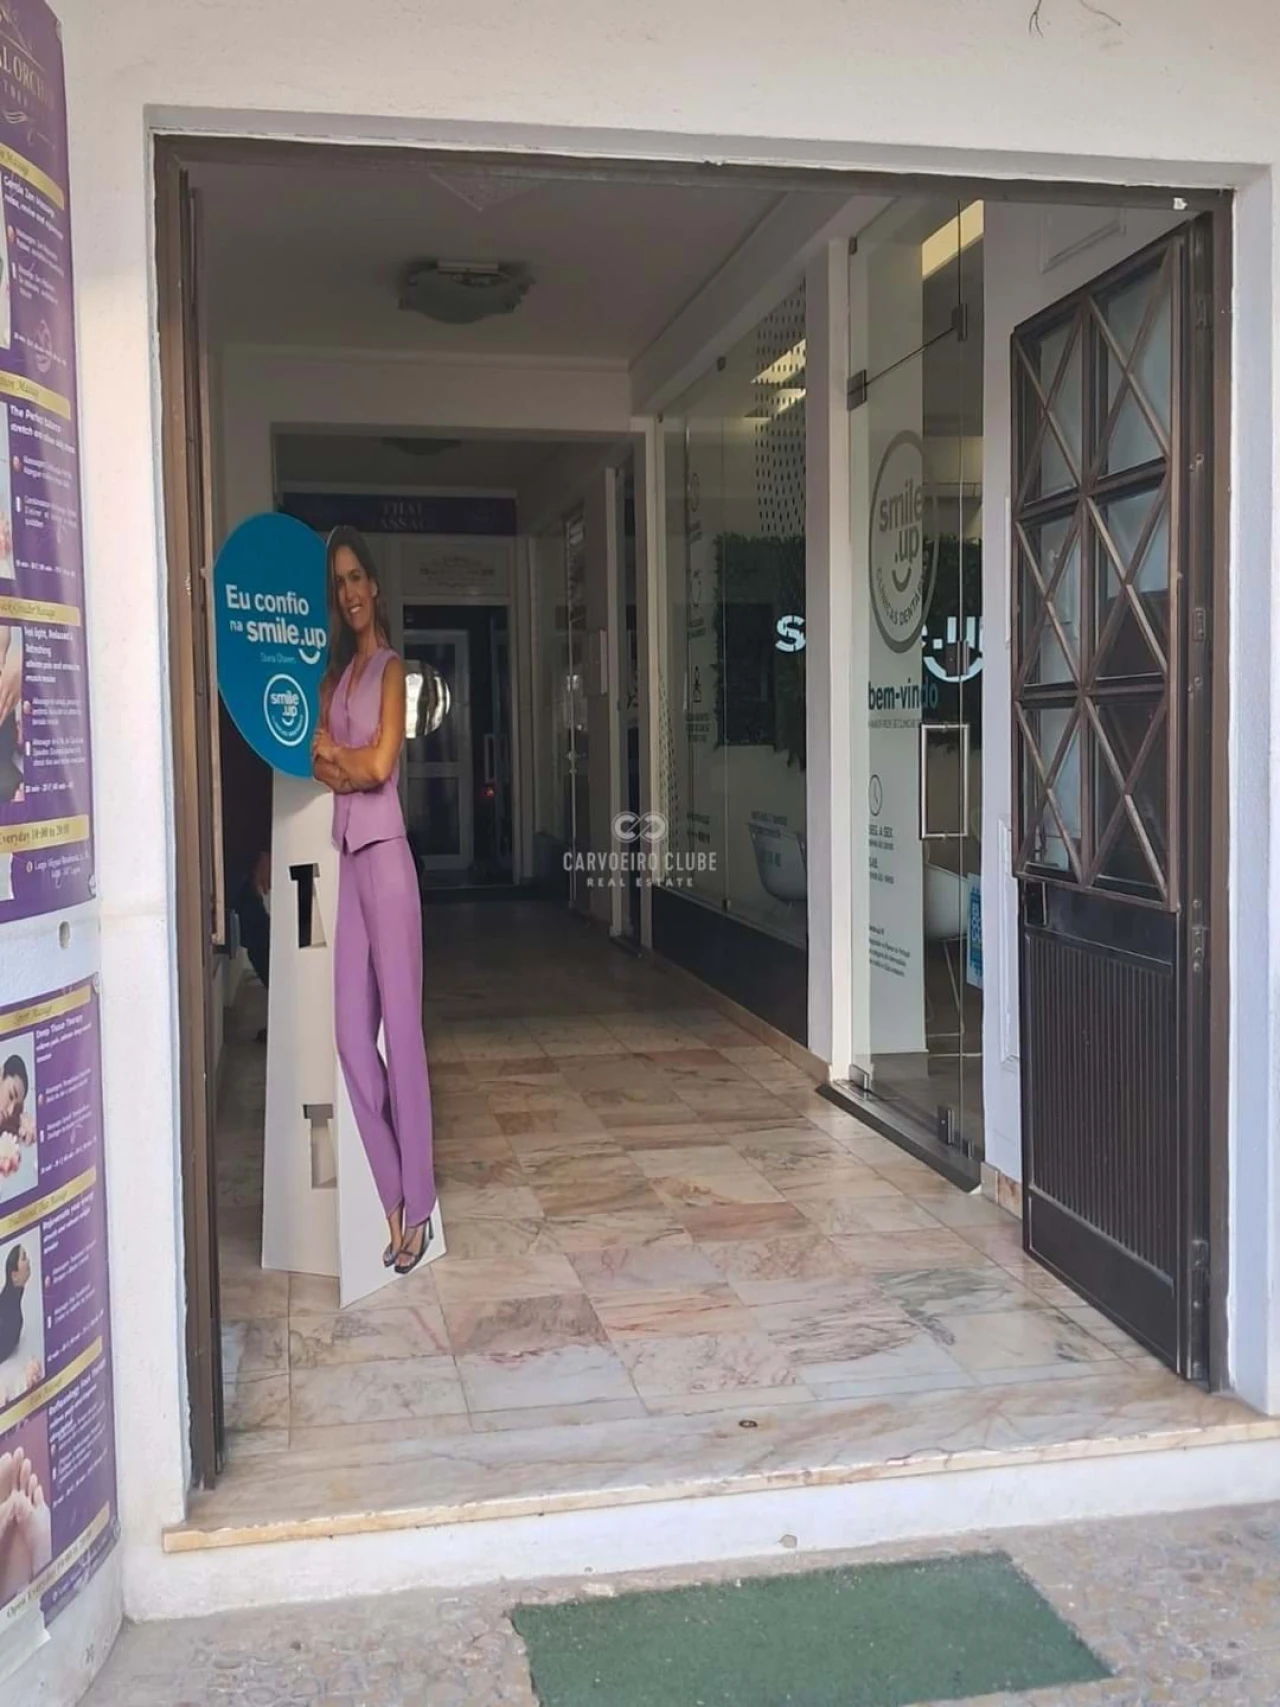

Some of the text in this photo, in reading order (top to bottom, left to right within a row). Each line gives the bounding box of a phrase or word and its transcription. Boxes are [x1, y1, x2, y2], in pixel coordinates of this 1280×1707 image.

[879, 478, 924, 533] smile
[225, 584, 310, 616] Eu confio
[229, 617, 327, 650] na smile.up
[270, 690, 300, 706] smile
[868, 678, 938, 711] bem-vindo
